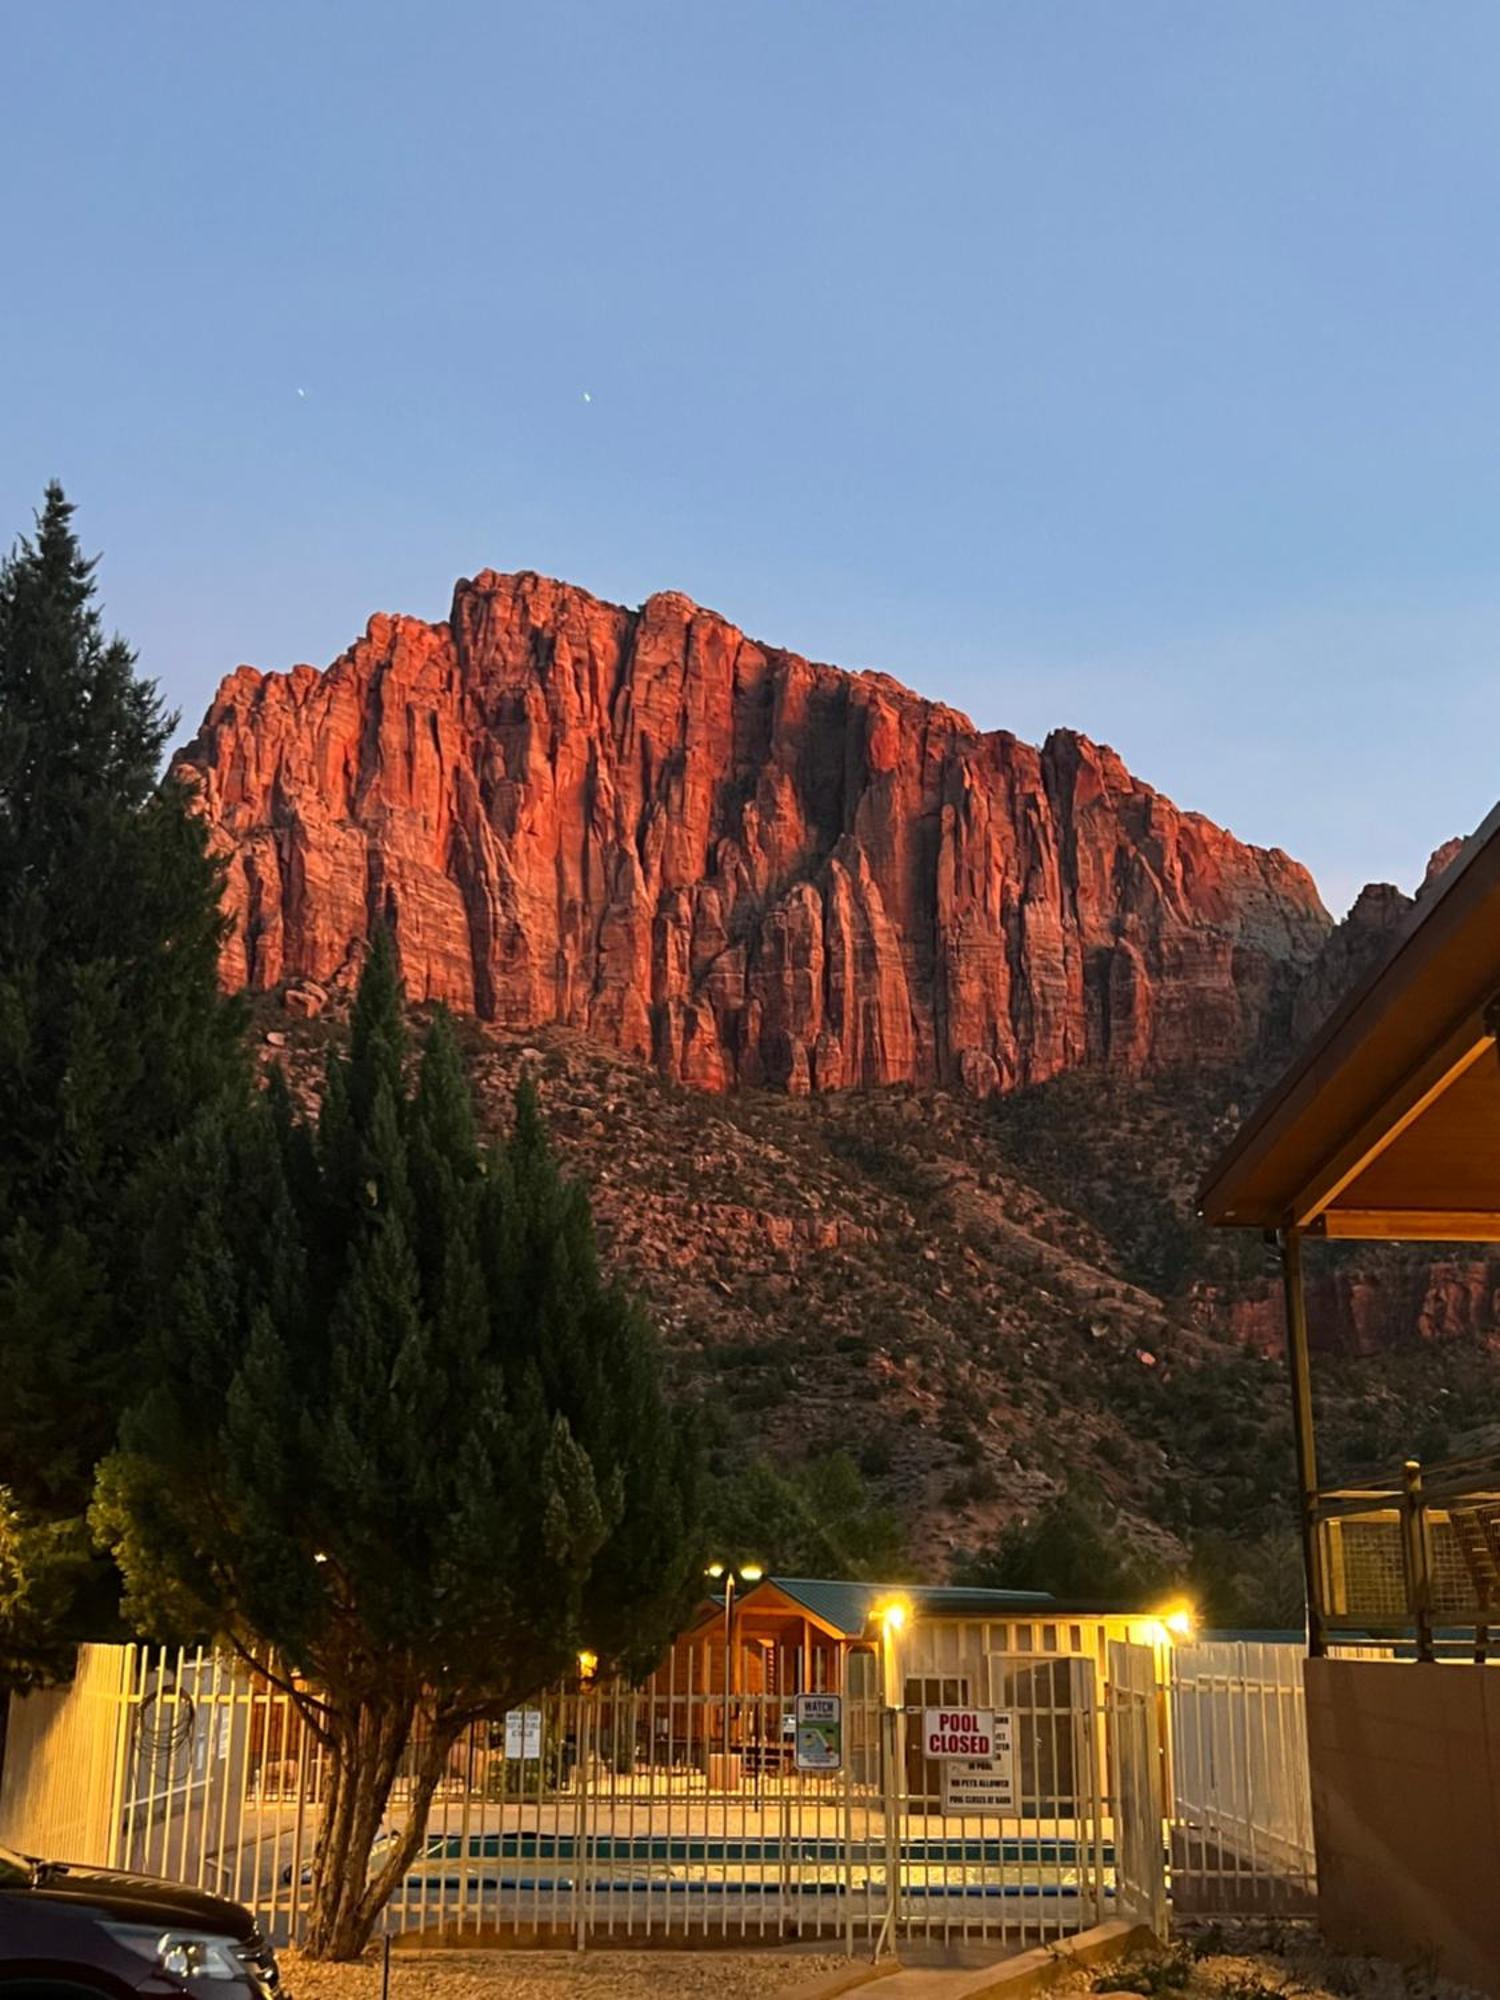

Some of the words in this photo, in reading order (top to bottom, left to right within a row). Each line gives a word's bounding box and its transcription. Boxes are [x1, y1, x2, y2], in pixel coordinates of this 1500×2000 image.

[804, 1701, 833, 1712] WATCH
[939, 1713, 979, 1732] POOL
[929, 1734, 989, 1754] CLOSED
[951, 1779, 960, 1787] NO
[961, 1779, 977, 1788] PETS
[979, 1780, 1009, 1788] ALLOWED
[949, 1796, 963, 1804] POOL
